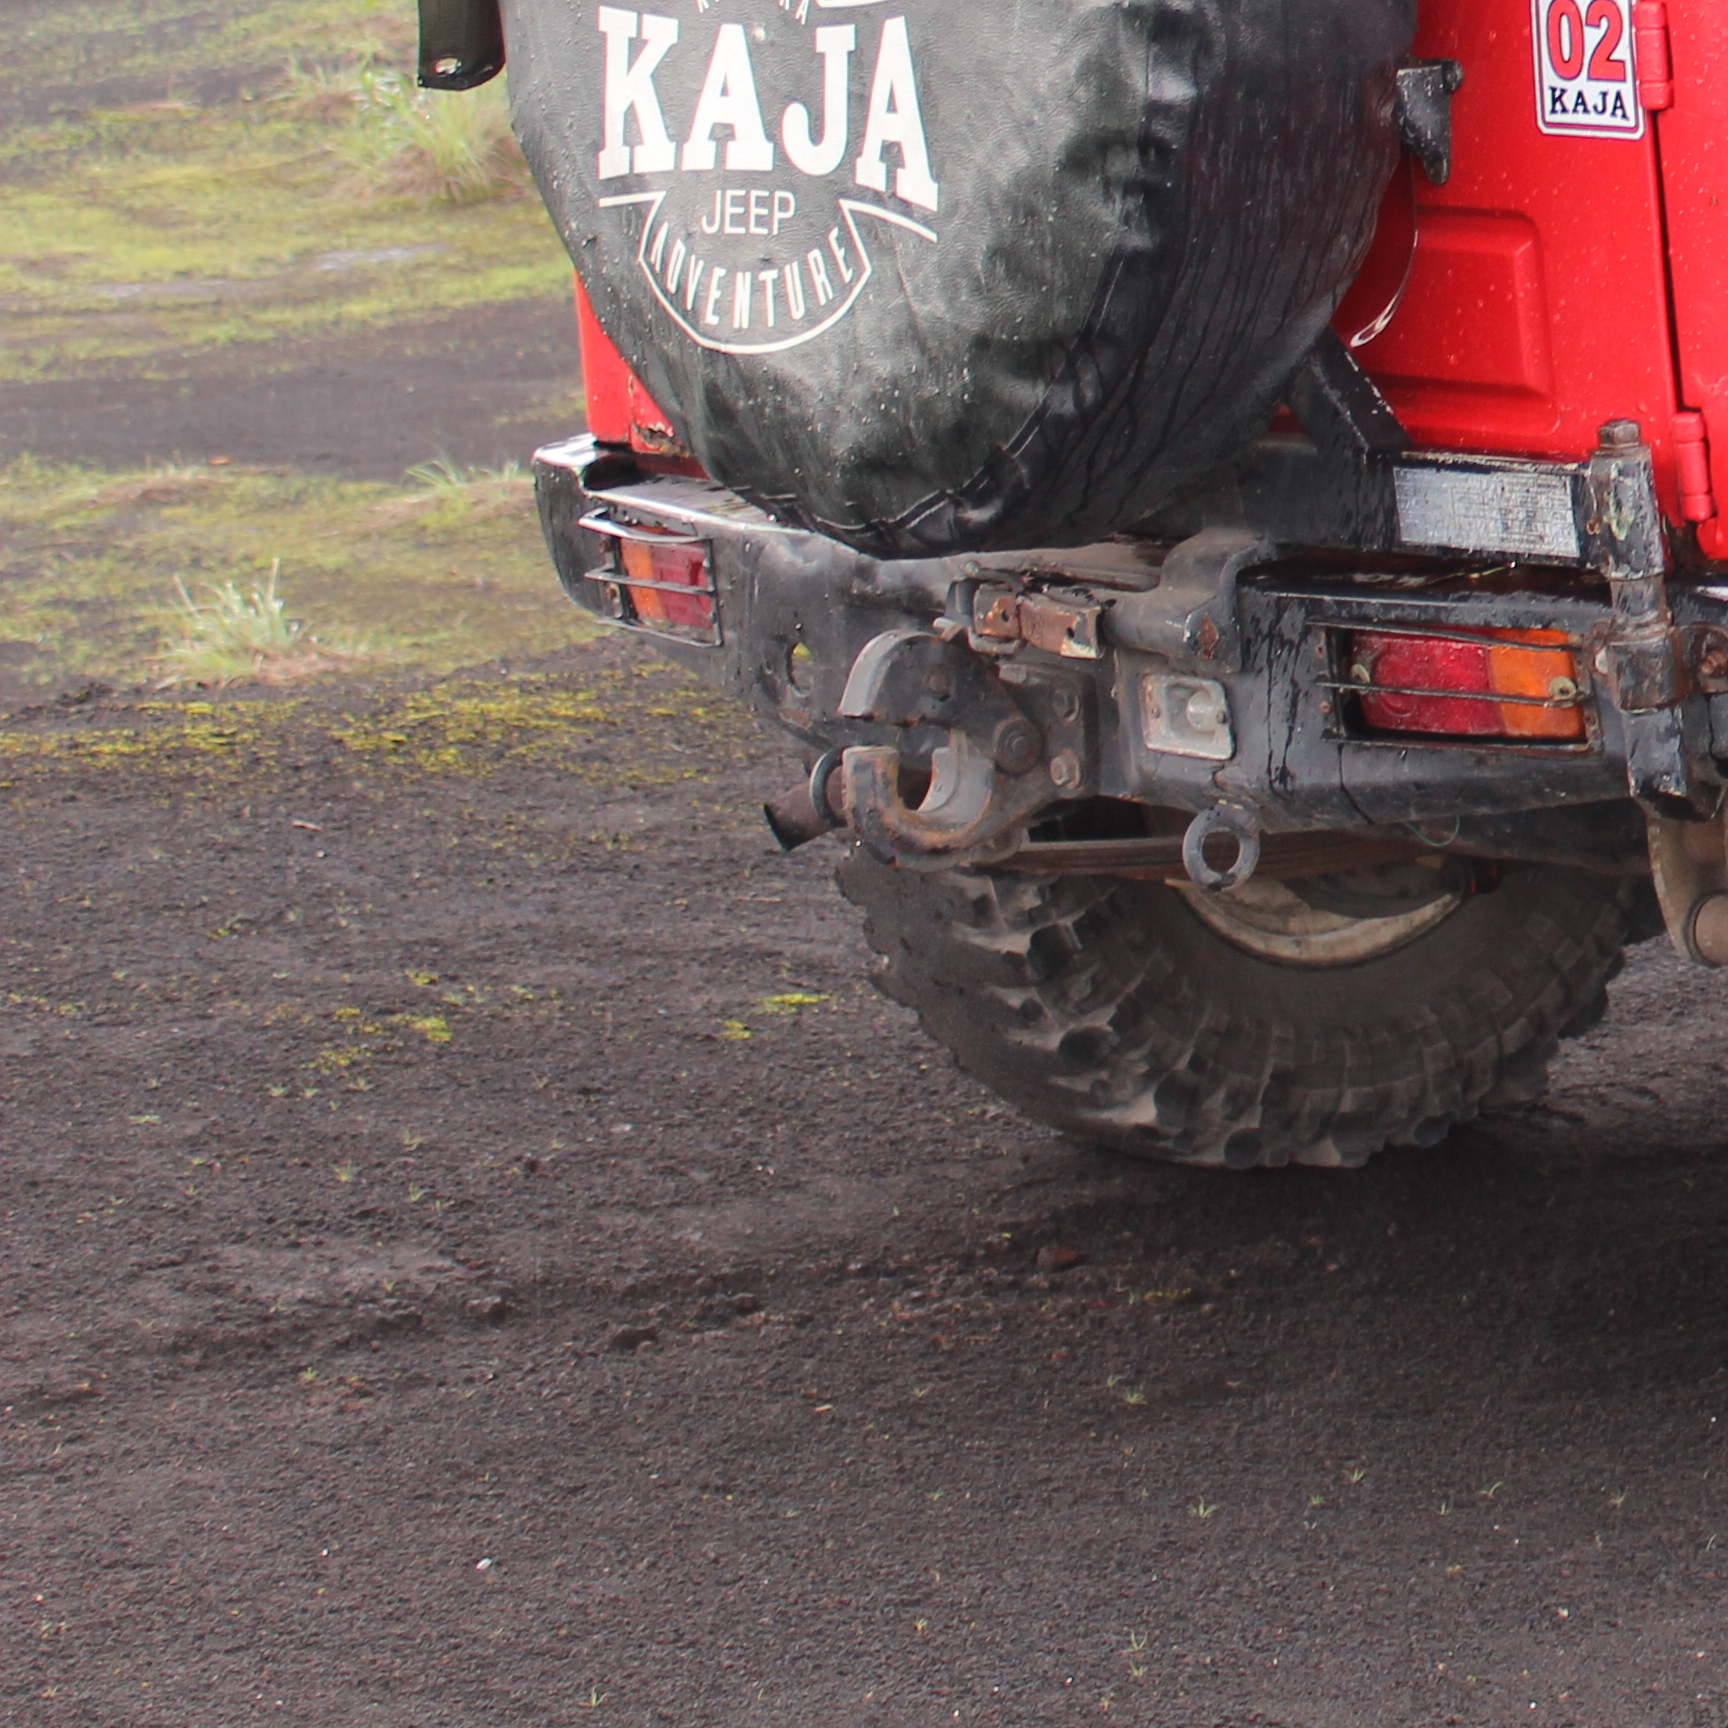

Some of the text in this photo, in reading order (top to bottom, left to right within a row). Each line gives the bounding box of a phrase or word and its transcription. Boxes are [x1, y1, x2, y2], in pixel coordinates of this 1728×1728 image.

[598, 4, 938, 212] KAJA
[1548, 85, 1630, 122] KAJA
[701, 188, 797, 236] JEEP
[651, 220, 854, 329] ADVENTURE
